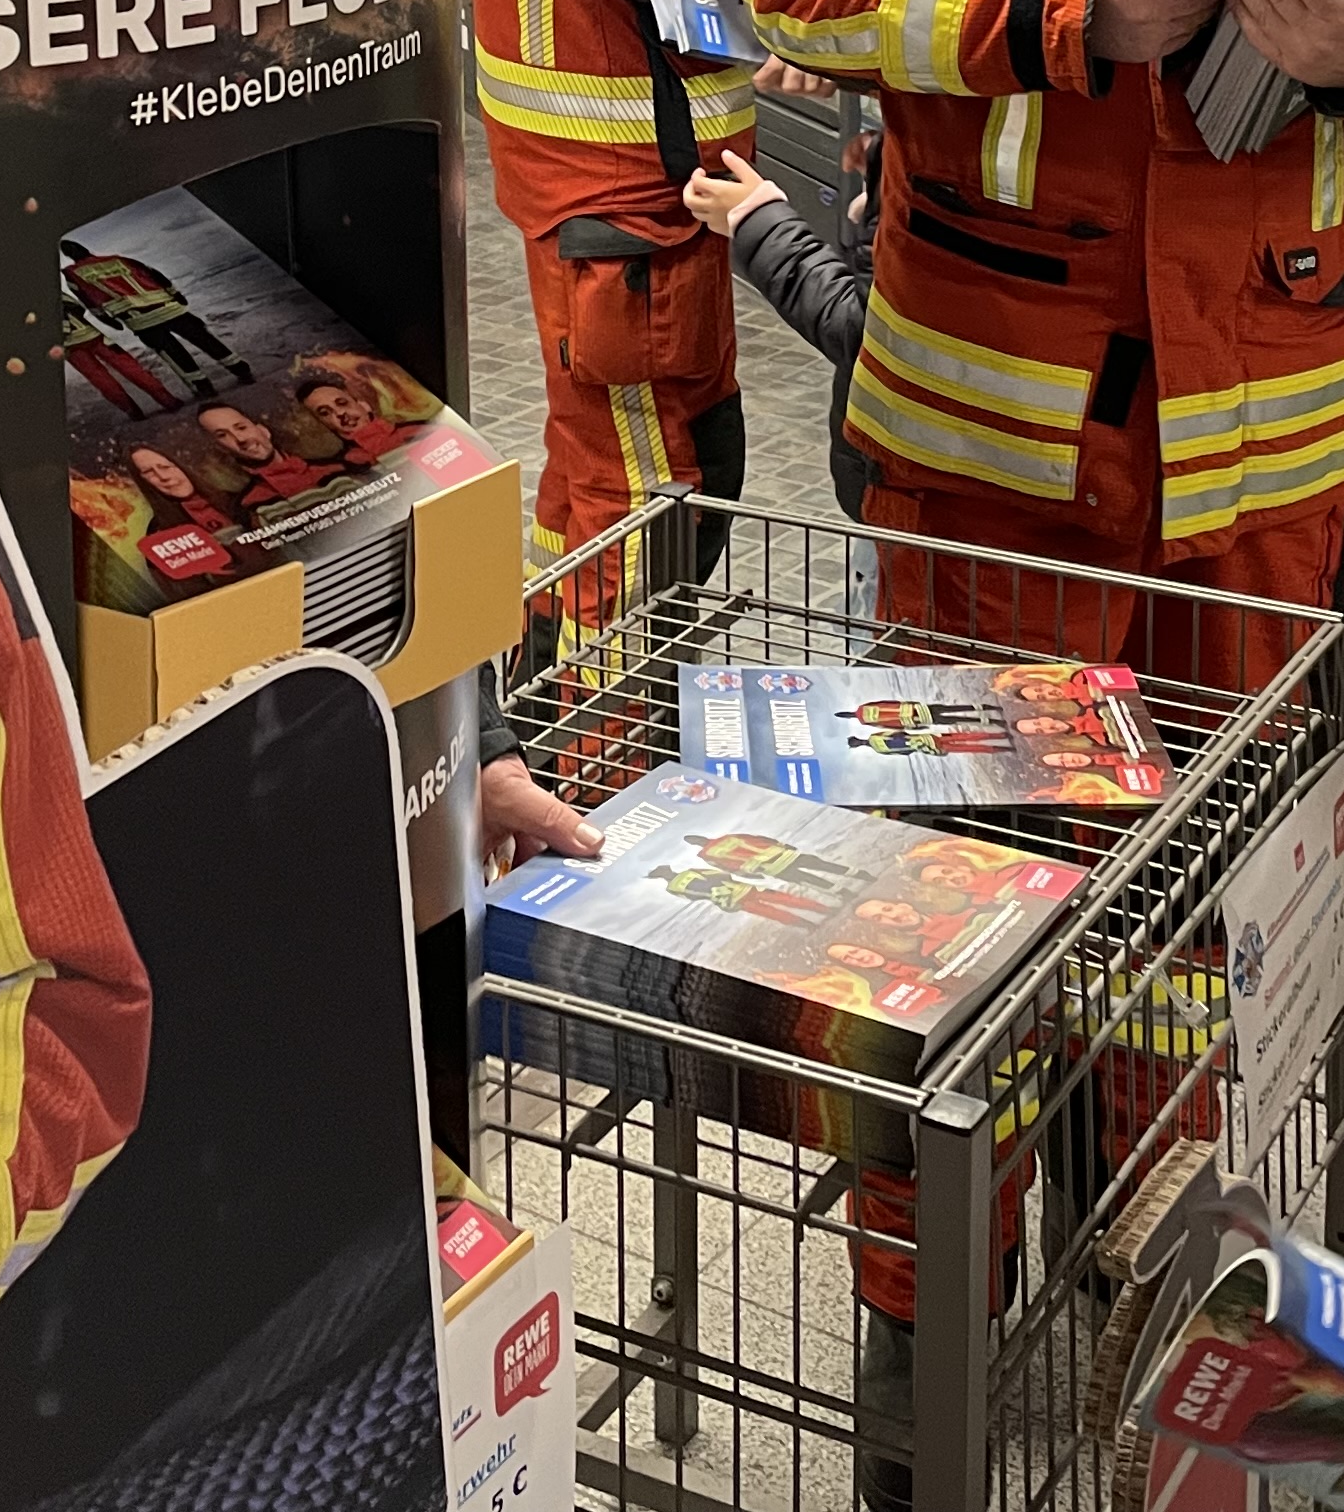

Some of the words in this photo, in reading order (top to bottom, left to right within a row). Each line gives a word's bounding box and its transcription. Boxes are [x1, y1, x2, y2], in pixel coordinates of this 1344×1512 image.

[130, 26, 422, 127] #KlebeDeinenTraum
[420, 438, 459, 466] STICKER
[432, 448, 463, 470] STARS
[152, 532, 205, 559] REWE
[165, 554, 189, 570] Dein
[186, 546, 216, 565] Markt
[405, 719, 466, 829] ARS.DE
[443, 1216, 480, 1254] STICKER
[454, 1229, 484, 1259] STARS
[503, 1310, 551, 1371] REWE
[503, 1360, 524, 1397] DEIN
[1174, 1351, 1231, 1421] REWE
